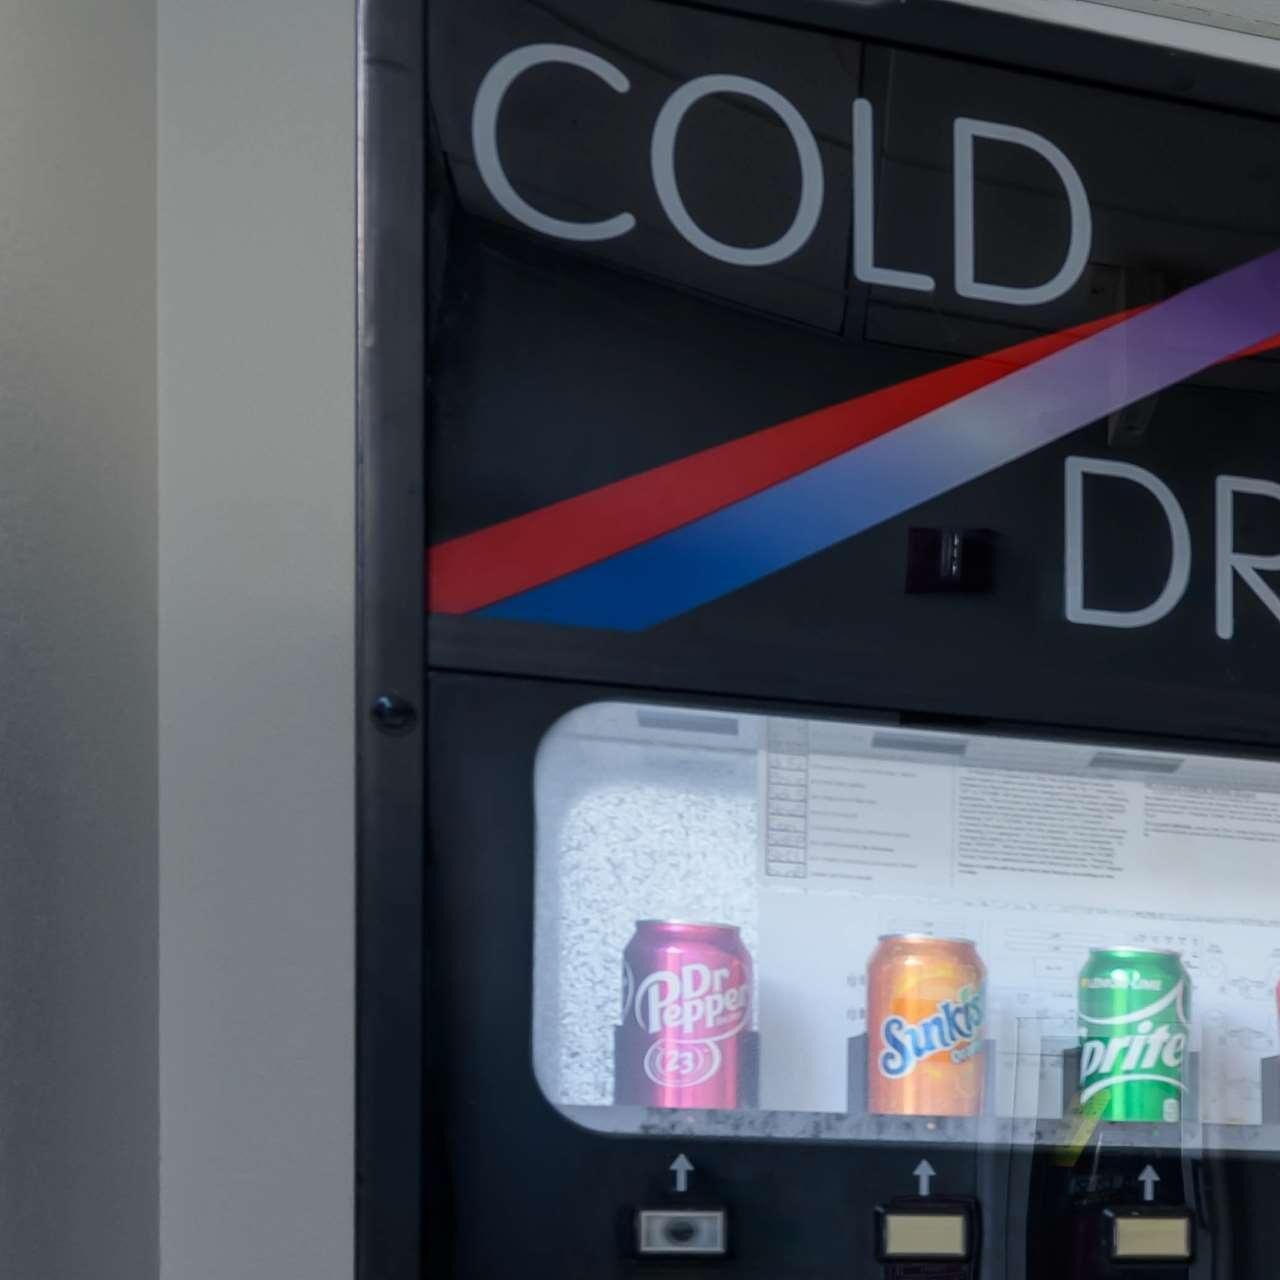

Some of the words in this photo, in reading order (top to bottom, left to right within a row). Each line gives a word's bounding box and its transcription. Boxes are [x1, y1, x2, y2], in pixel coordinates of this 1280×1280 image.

[472, 43, 1092, 305] COLD
[636, 970, 749, 1034] Pepper
[682, 963, 729, 1001] Dr
[668, 1050, 694, 1074] 23
[1079, 1021, 1185, 1086] prite
